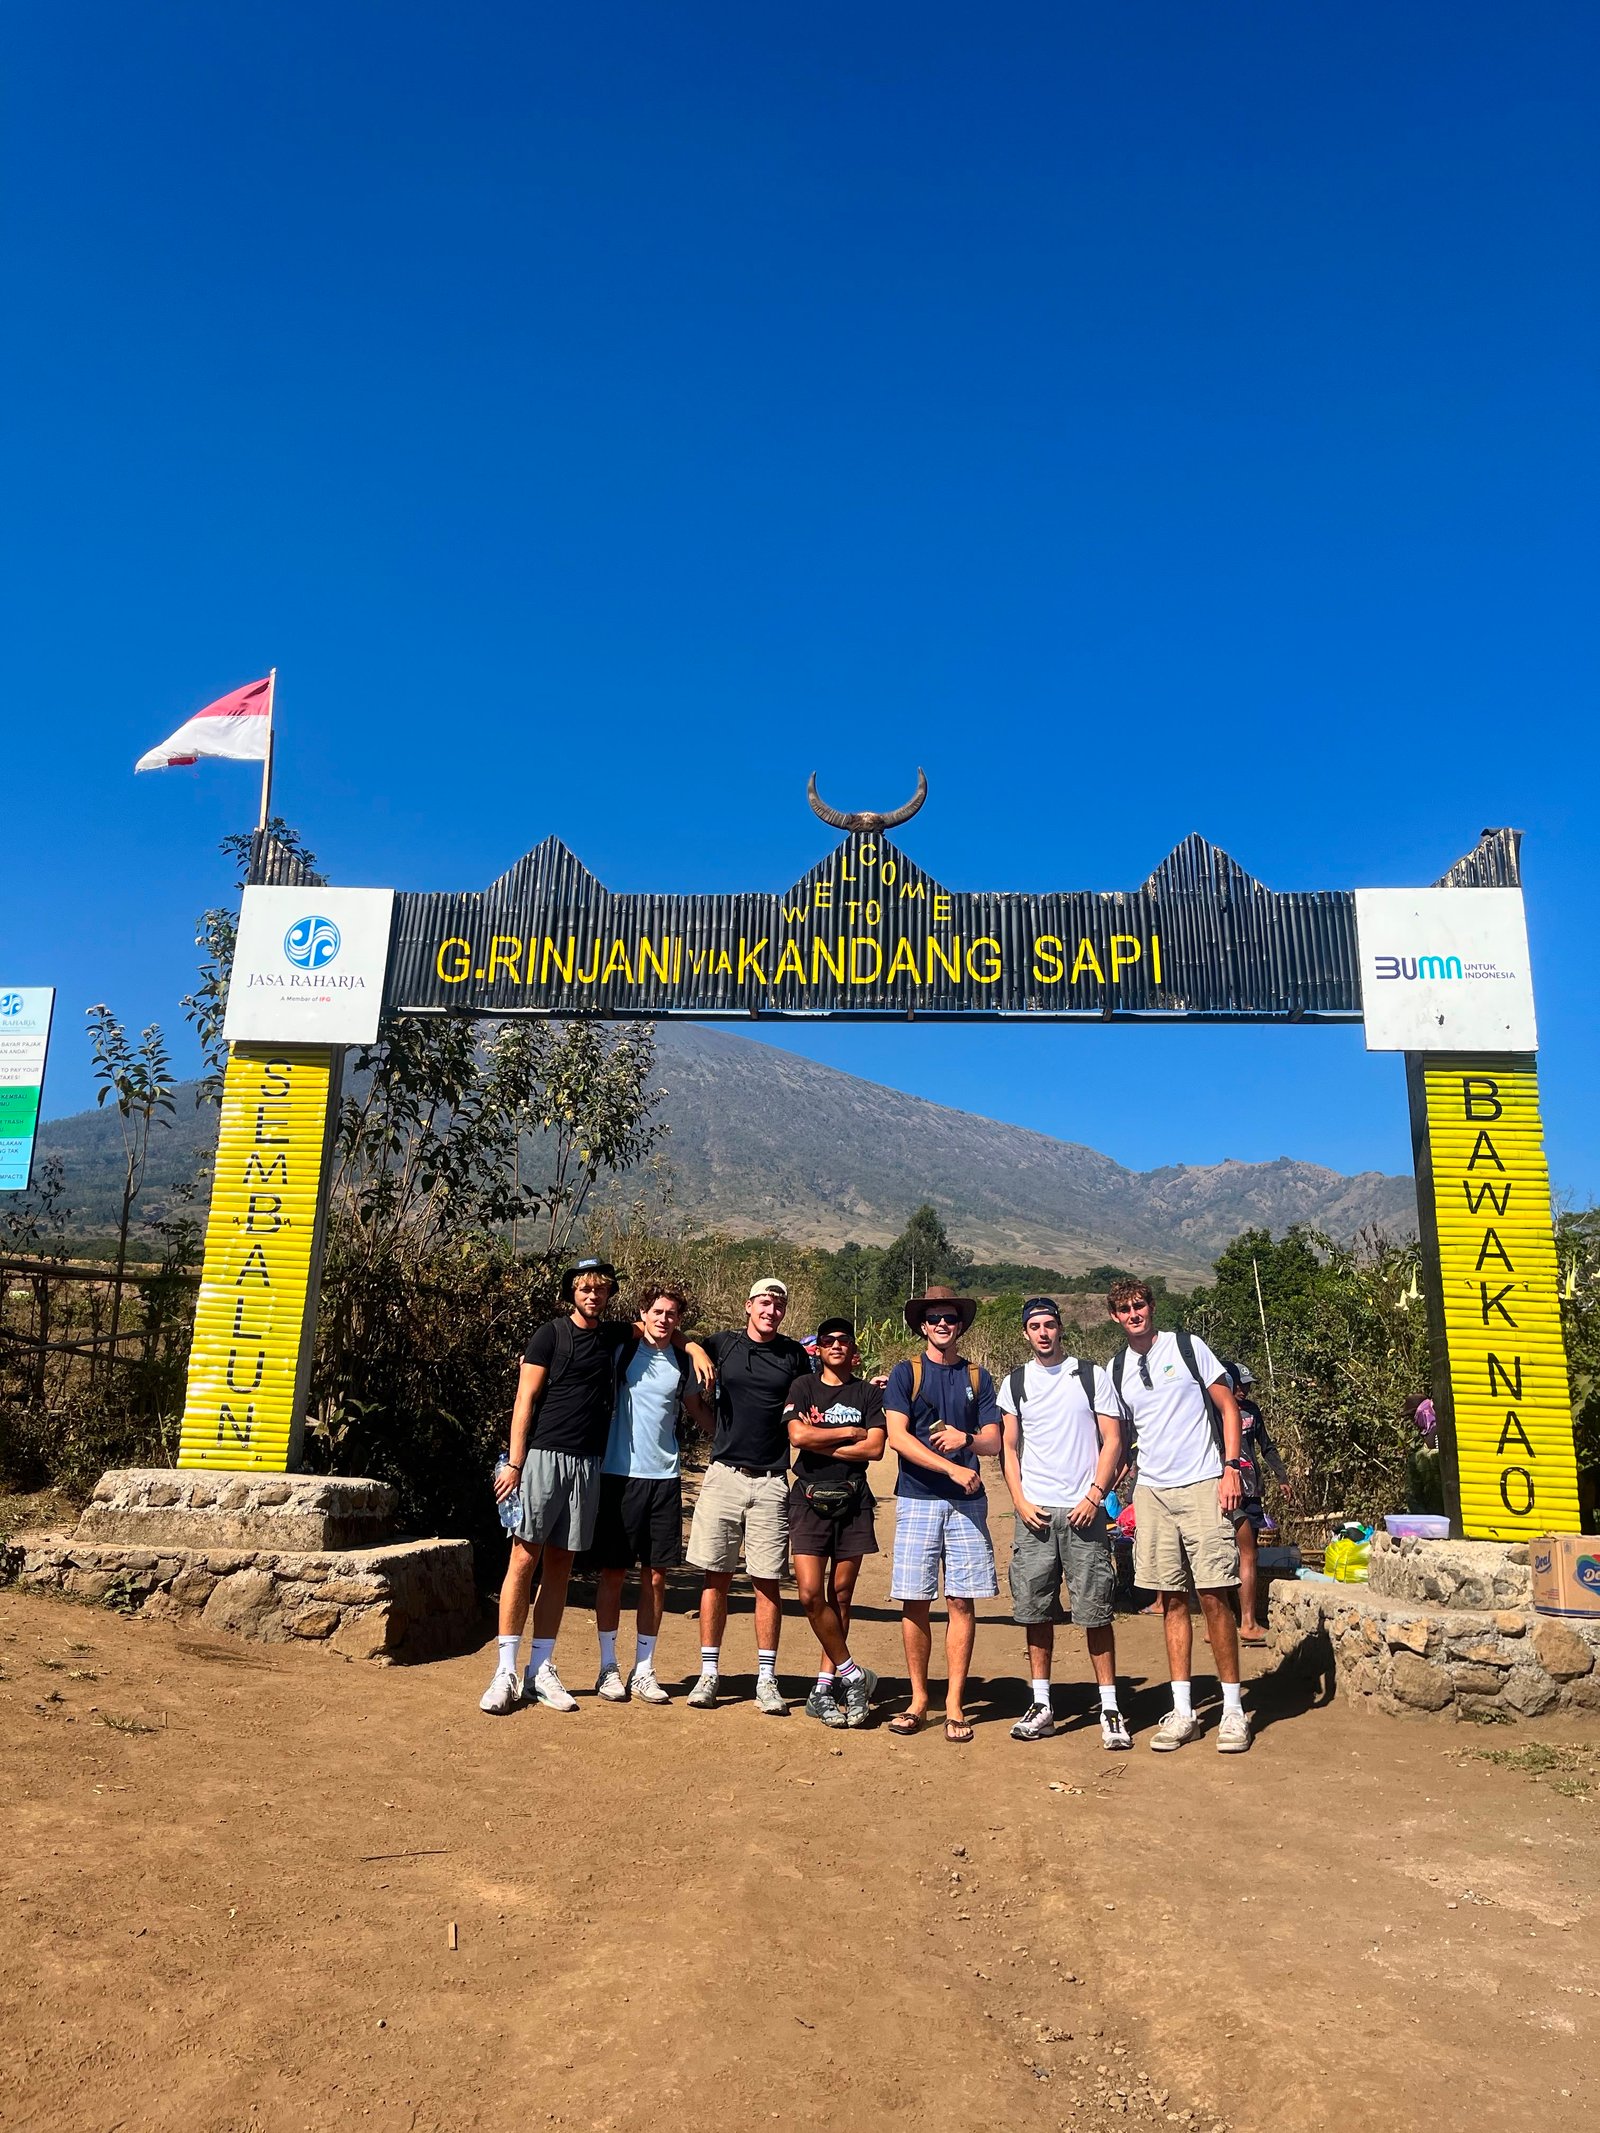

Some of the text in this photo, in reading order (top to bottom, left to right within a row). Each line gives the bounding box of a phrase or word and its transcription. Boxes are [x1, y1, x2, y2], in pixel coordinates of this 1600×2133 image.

[782, 843, 951, 925] WELCOME
[848, 899, 881, 925] TO
[437, 935, 1163, 985] G.RINJANI VIA KANDANG SAPI
[1464, 963, 1497, 971] UNTUK
[247, 973, 367, 990] JASA RAHARJA
[216, 1057, 292, 1449] SEMBALUN
